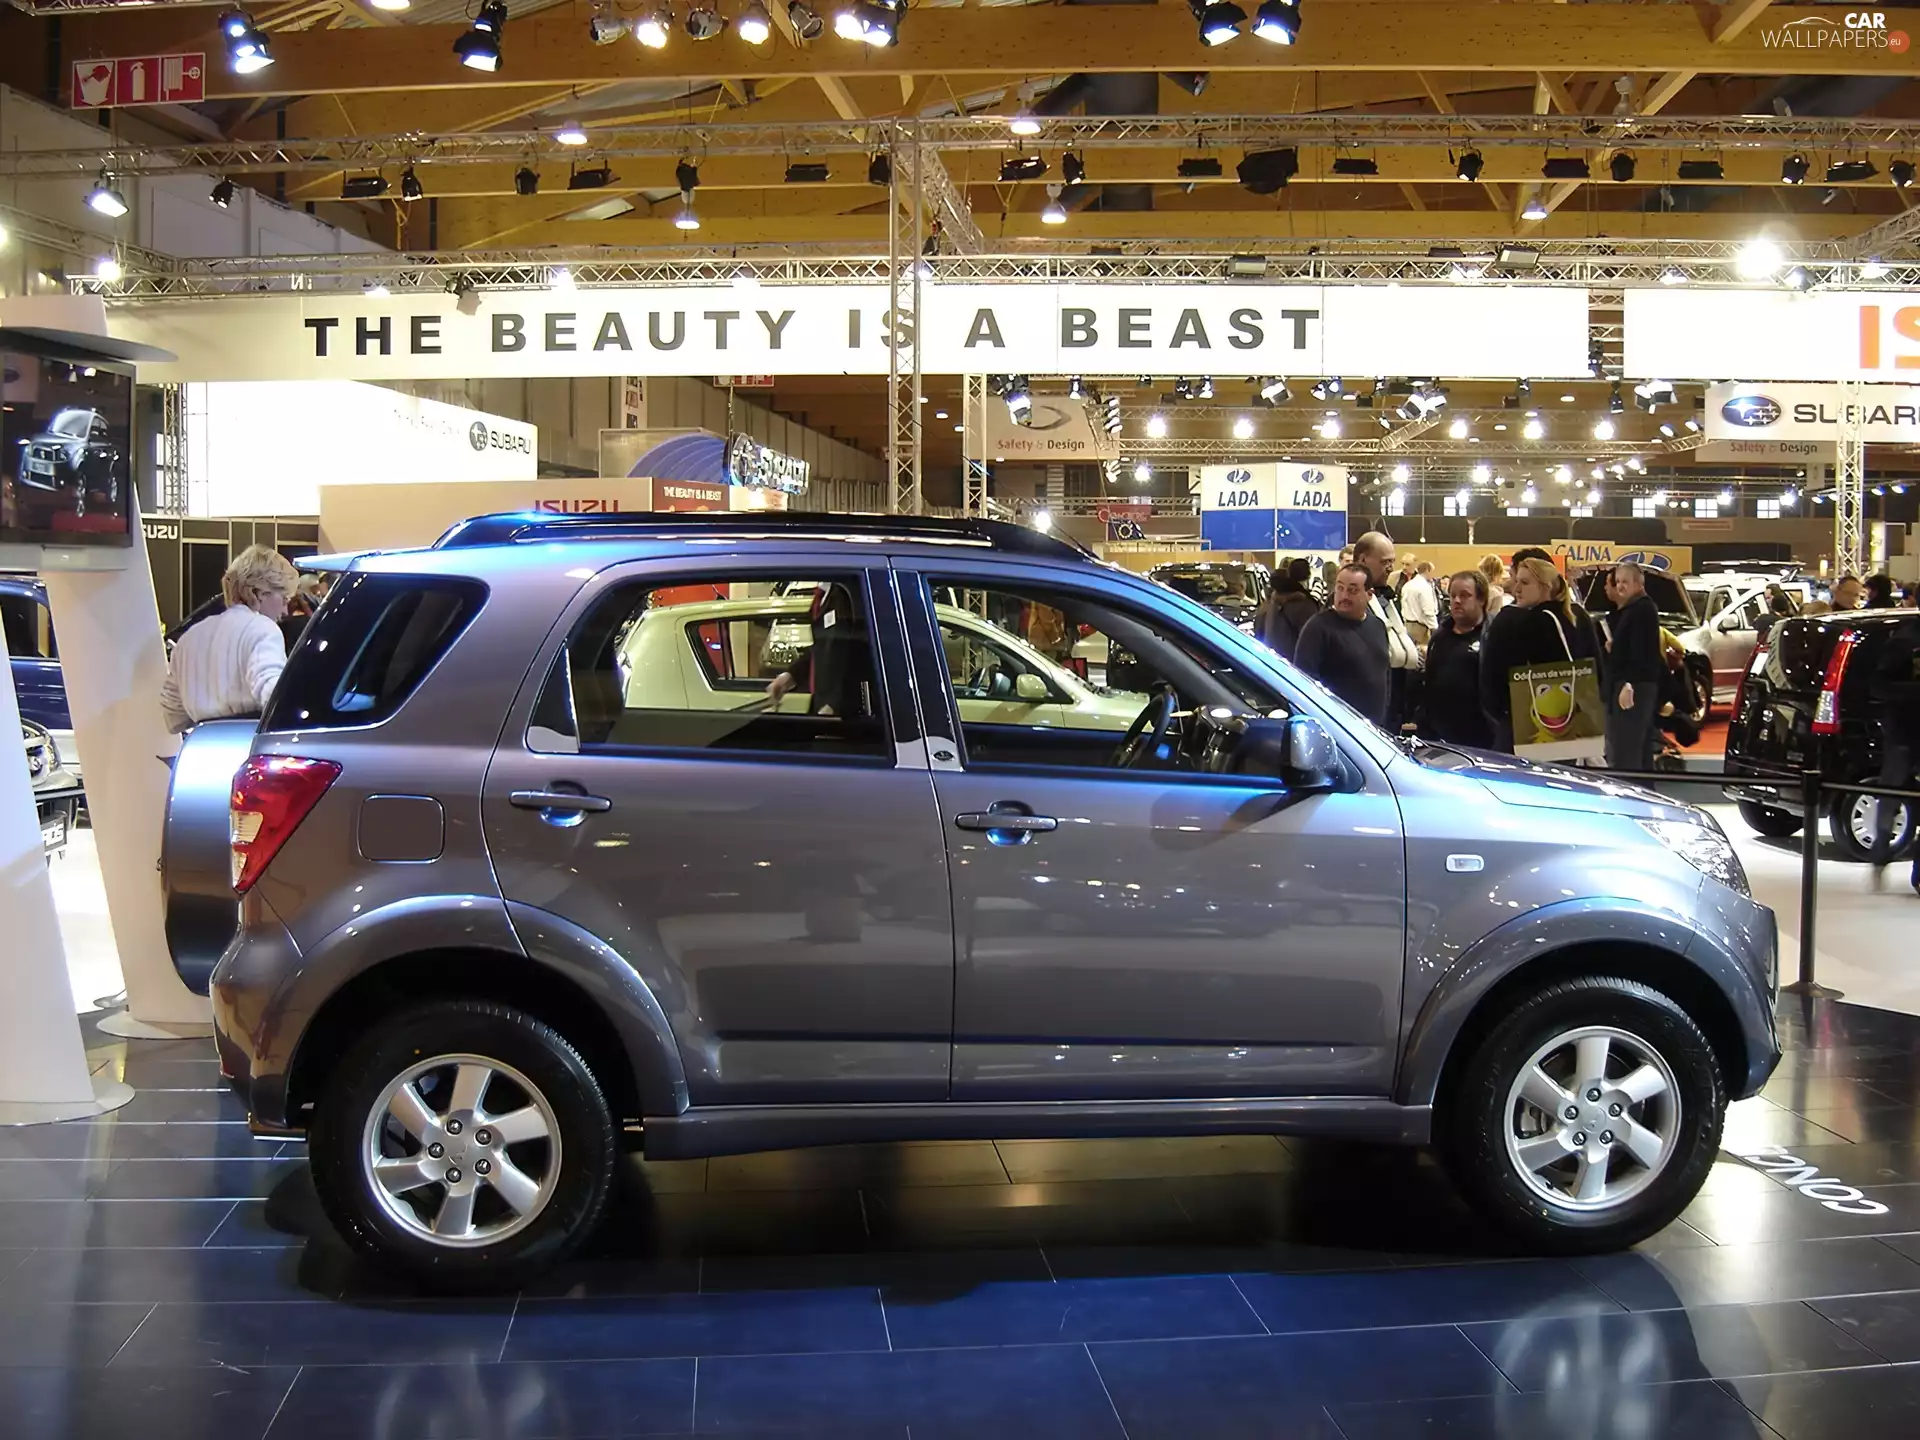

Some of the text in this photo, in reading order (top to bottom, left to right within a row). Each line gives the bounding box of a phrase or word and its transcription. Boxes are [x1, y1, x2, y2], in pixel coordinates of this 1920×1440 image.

[304, 307, 1320, 357] THE BEAUTY IS A BEAST
[1793, 403, 1920, 425] SUBAR
[490, 430, 531, 455] SUBARU
[997, 439, 1033, 451] Safety
[1047, 439, 1085, 451] Design
[1730, 441, 1766, 454] Safety
[1780, 442, 1818, 455] Design
[1218, 490, 1259, 507] LADA
[1293, 490, 1332, 507] LADA
[1559, 667, 1592, 677] vregde
